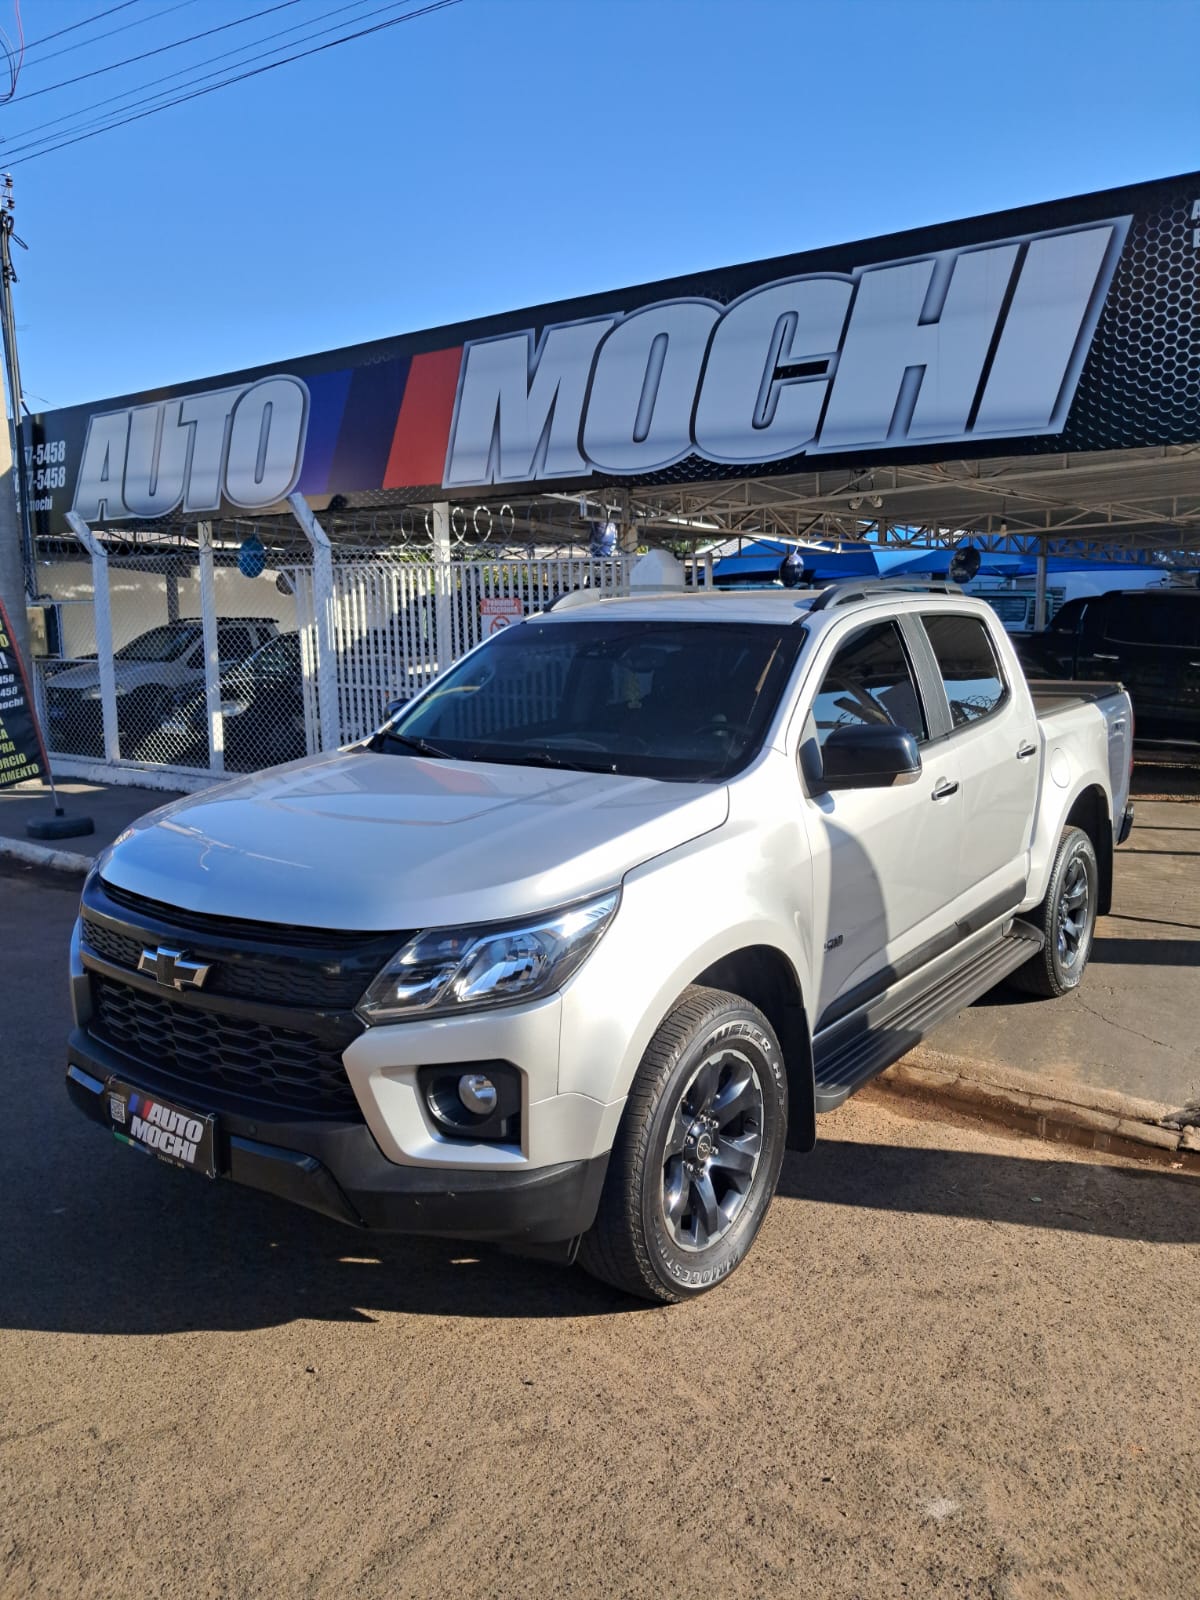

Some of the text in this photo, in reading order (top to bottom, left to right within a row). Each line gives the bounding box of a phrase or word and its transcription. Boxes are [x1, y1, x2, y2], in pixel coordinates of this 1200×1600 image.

[72, 214, 1133, 522] AUTO MOCHI
[130, 1115, 198, 1164] MOCHI
[146, 1102, 205, 1143] AUTO
